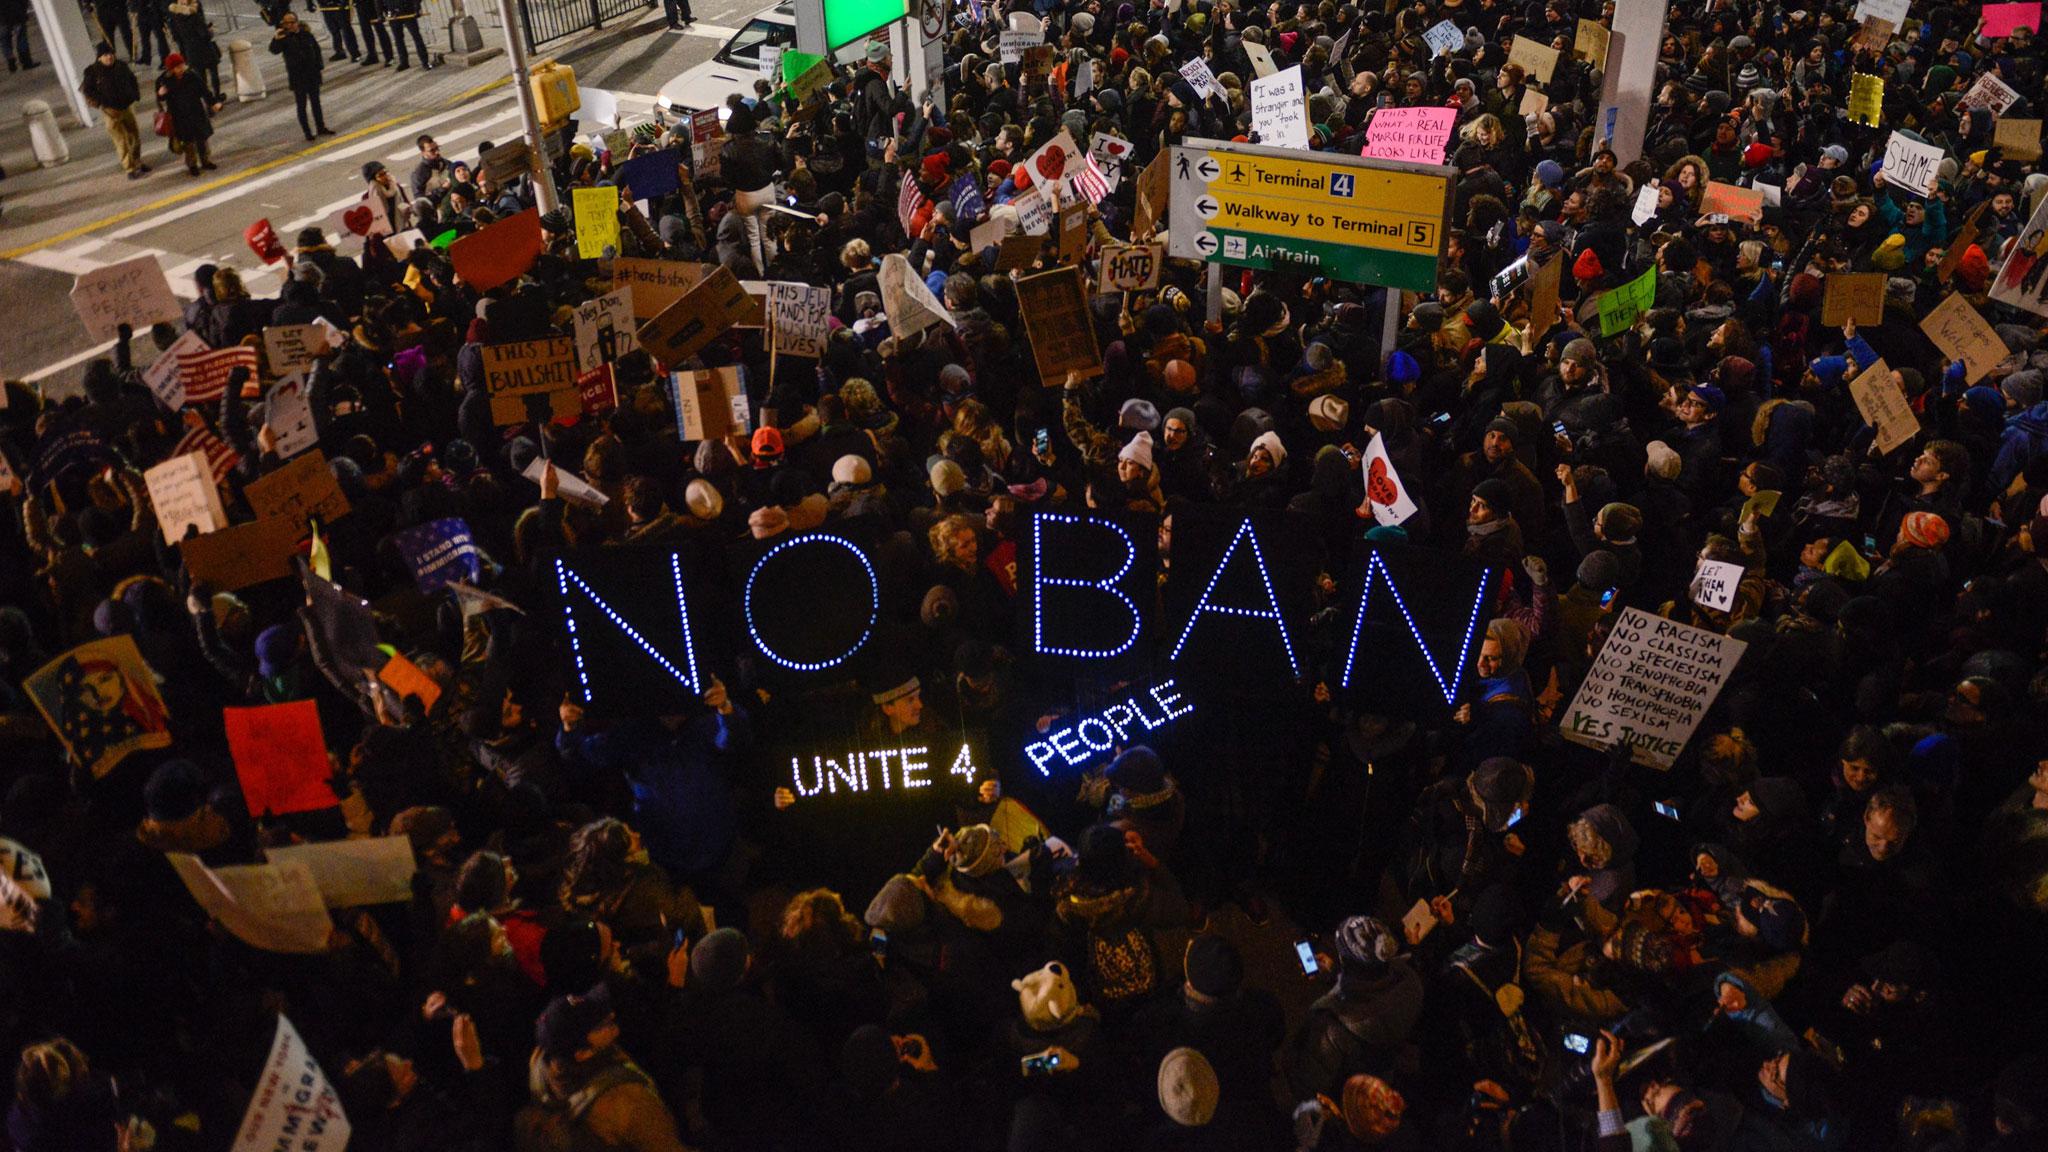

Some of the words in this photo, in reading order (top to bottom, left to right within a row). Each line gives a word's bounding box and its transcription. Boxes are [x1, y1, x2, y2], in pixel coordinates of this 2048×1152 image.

[1000, 40, 1041, 48] IMMIGRANT
[1269, 87, 1286, 96] was
[1289, 83, 1295, 92] a
[1978, 76, 2015, 105] REFUGEES
[1255, 101, 1288, 118] stranger
[1259, 119, 1273, 129] you
[1280, 114, 1299, 125] took
[1381, 109, 1408, 118] THIS
[1417, 108, 1427, 118] IS
[1374, 120, 1405, 129] WHAT
[1417, 120, 1448, 131] REAL
[1095, 139, 1107, 152] I
[1371, 132, 1405, 142] MARCH
[1425, 135, 1445, 147] LIFE
[1370, 146, 1405, 157] LOOKS
[1410, 148, 1439, 160] LIKE
[1884, 140, 1939, 188] SHAME
[1256, 169, 1325, 190] Terminal
[1333, 173, 1351, 197] 4
[1021, 195, 1072, 222] IMMIGRNT
[1225, 202, 1300, 227] Walkway
[1308, 210, 1325, 227] to
[1332, 215, 1403, 237] Terminal
[1413, 225, 1427, 243] 5
[1112, 254, 1151, 279] HATE
[1252, 245, 1321, 265] AirTrain
[768, 283, 798, 300] THIS
[799, 287, 830, 309] JEW
[1615, 277, 1648, 306] LET
[578, 303, 597, 325] Hey
[808, 304, 828, 325] FOR
[1604, 303, 1640, 327] THEM
[490, 342, 537, 362] THIS
[547, 338, 569, 357] IS
[1372, 469, 1393, 500] LOVE
[423, 539, 452, 562] STAND
[1702, 565, 1723, 576] LET
[1699, 590, 1712, 603] IN
[1700, 578, 1725, 593] THEM
[556, 533, 879, 701] NO
[1033, 513, 1491, 704] BAN
[1619, 612, 1647, 630] NO
[1656, 620, 1721, 652] RACISM
[1613, 627, 1640, 642] NO
[1647, 638, 1721, 668] CLASSISM
[1599, 653, 1622, 668] NO
[1627, 660, 1707, 696] XENOPHOBIA
[1607, 640, 1632, 656] NO
[1638, 649, 1721, 686] SPECIESISM
[1591, 667, 1614, 682] NO
[1619, 675, 1703, 711] TRANSPHOBIA
[1576, 693, 1603, 709] NO
[1609, 704, 1670, 731] SEXISM
[1583, 681, 1604, 695] NO
[1608, 688, 1693, 726] HOMOPHOBIA
[1023, 678, 1196, 777] PEOPLE
[1573, 710, 1613, 738] YES
[1619, 724, 1682, 757] JUSTICE
[791, 745, 932, 797] UNITE
[950, 743, 977, 785] 4
